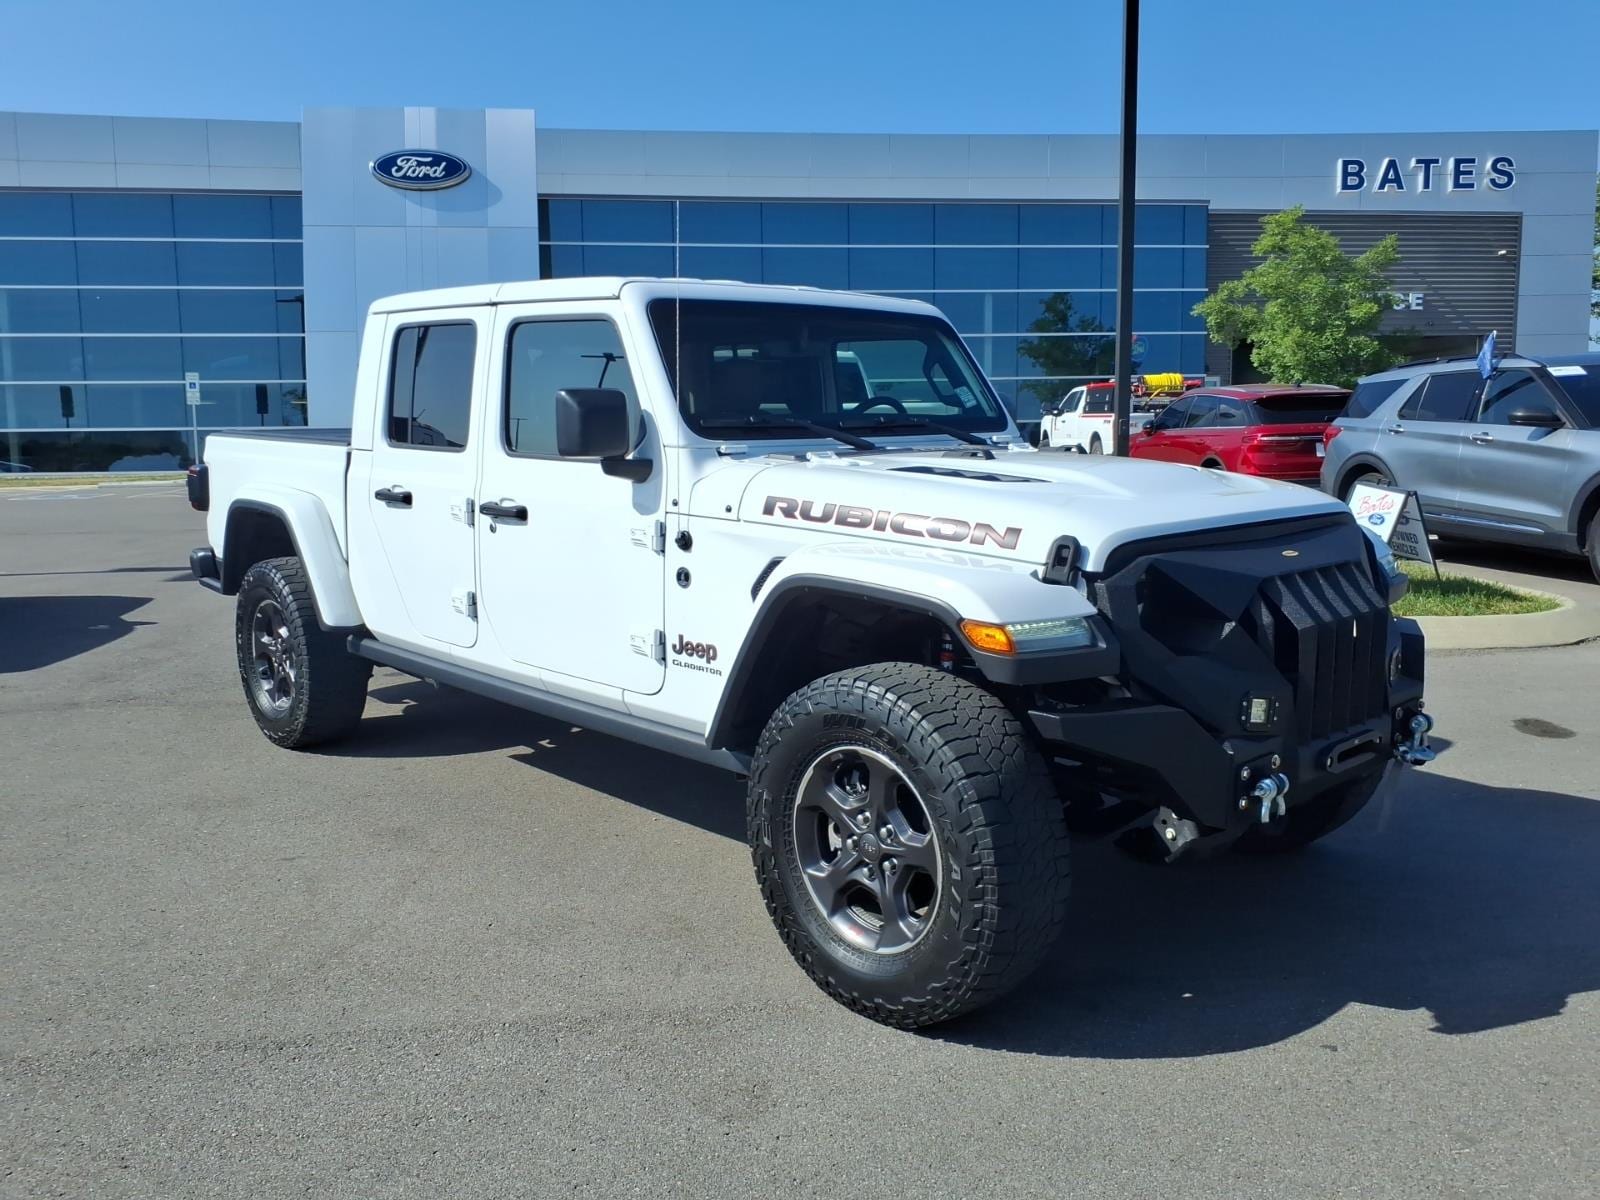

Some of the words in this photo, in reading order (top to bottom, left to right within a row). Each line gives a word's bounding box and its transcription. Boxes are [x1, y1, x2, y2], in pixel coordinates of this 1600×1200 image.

[391, 155, 447, 178] Ford
[1335, 156, 1516, 194] BATES
[762, 495, 1022, 550] RUBICON
[1391, 541, 1419, 556] EHICLES
[672, 633, 718, 664] Jeep
[672, 659, 722, 677] GLADIATOR
